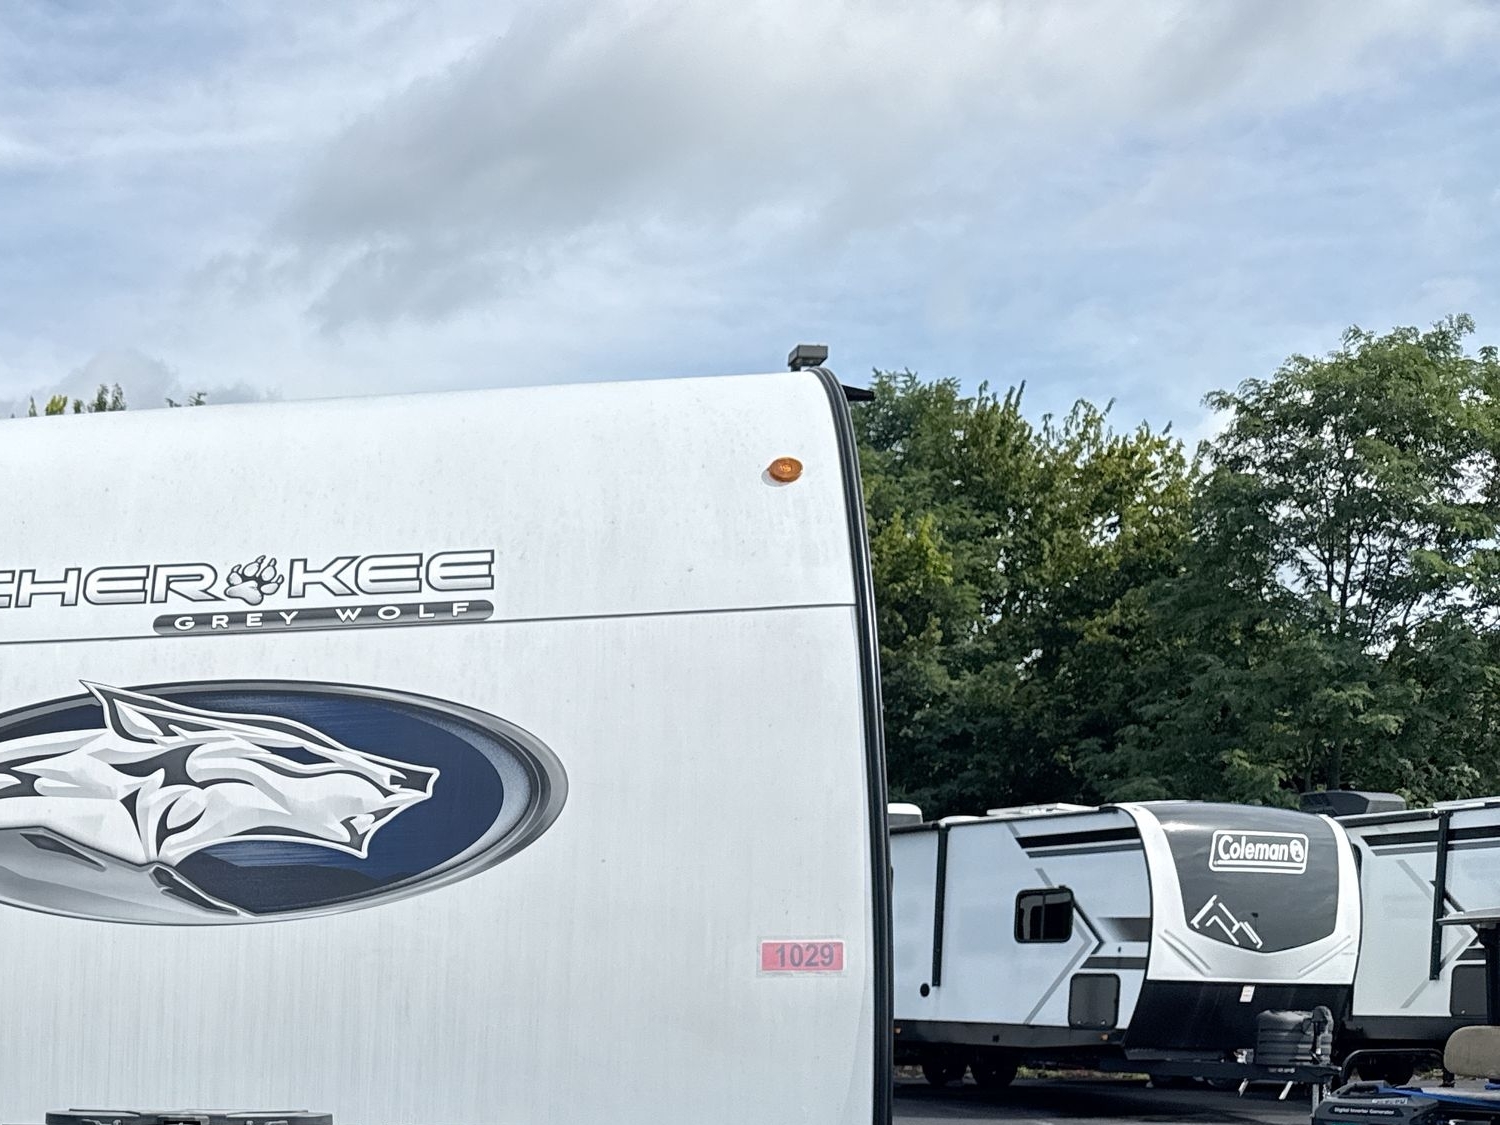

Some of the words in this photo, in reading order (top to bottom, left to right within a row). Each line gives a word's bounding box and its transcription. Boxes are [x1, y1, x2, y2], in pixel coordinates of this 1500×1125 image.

[174, 610, 298, 630] GREY
[335, 602, 469, 622] WOLF
[1218, 835, 1289, 861] Coleman
[776, 943, 834, 967] 1029
